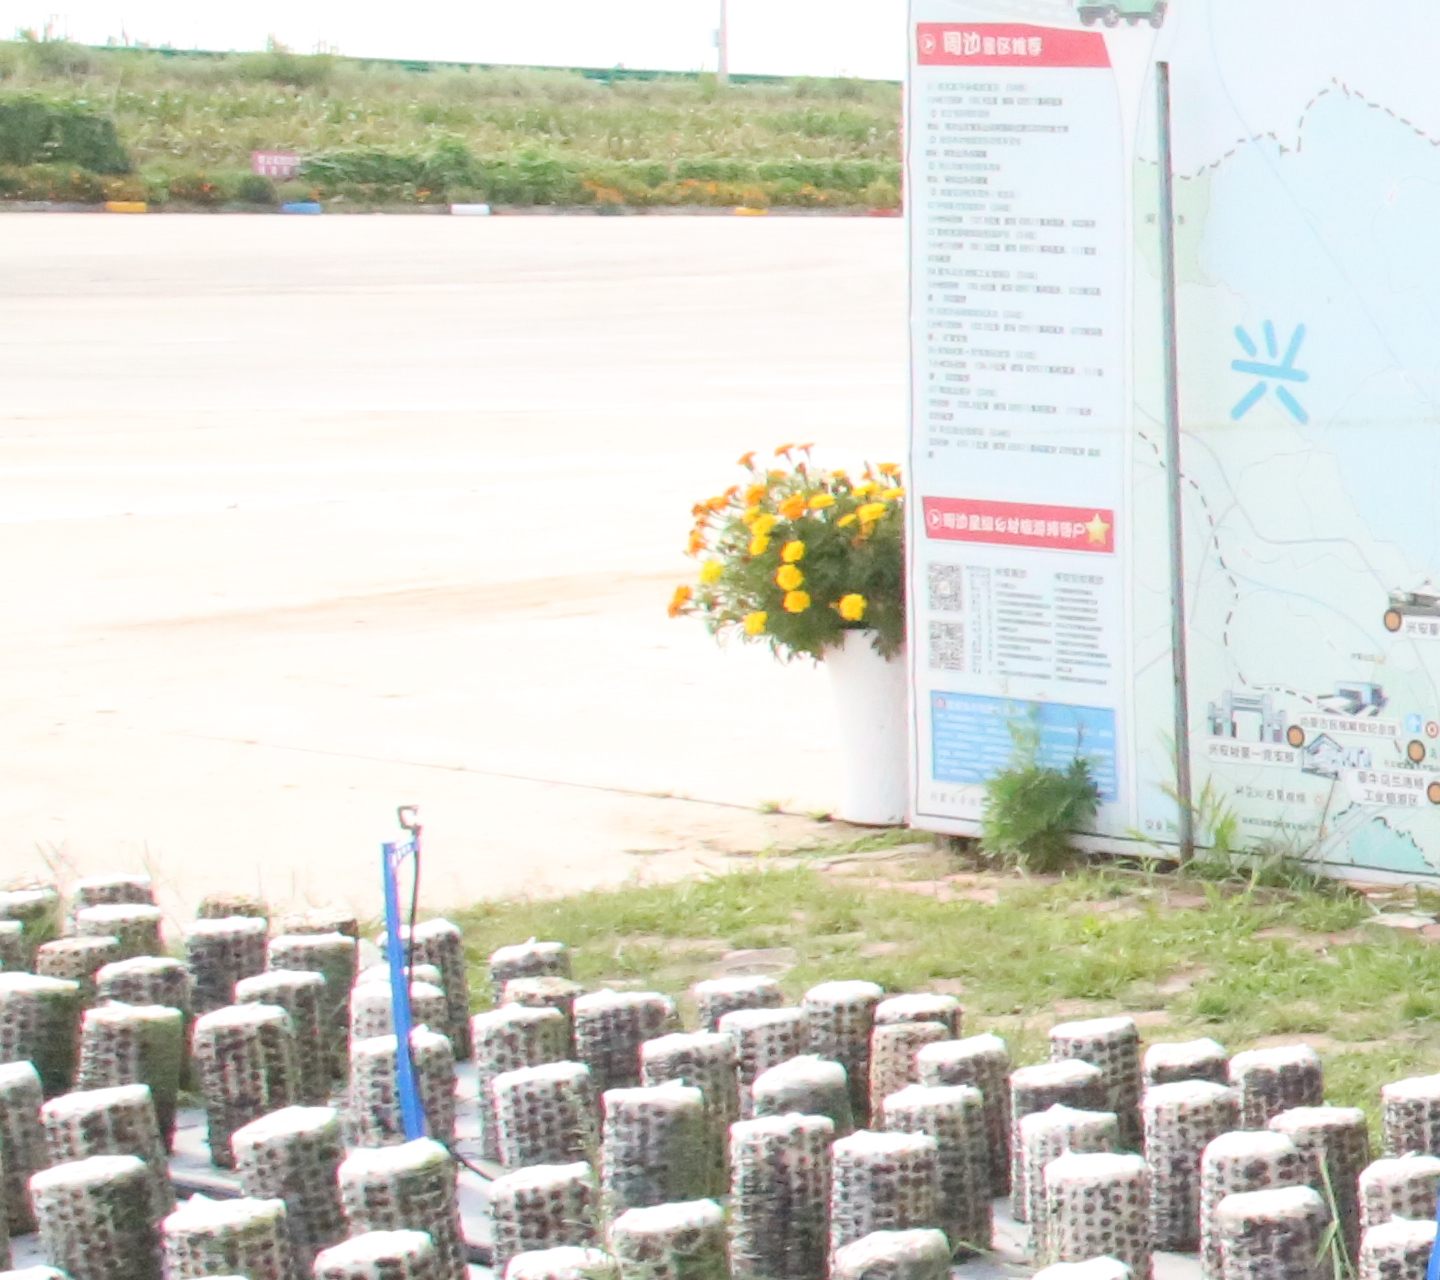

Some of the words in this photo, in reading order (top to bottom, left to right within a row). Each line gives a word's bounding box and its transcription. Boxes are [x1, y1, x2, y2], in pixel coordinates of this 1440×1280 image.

[942, 31, 1042, 56] 周边景区推荐
[1230, 319, 1309, 424] 兴
